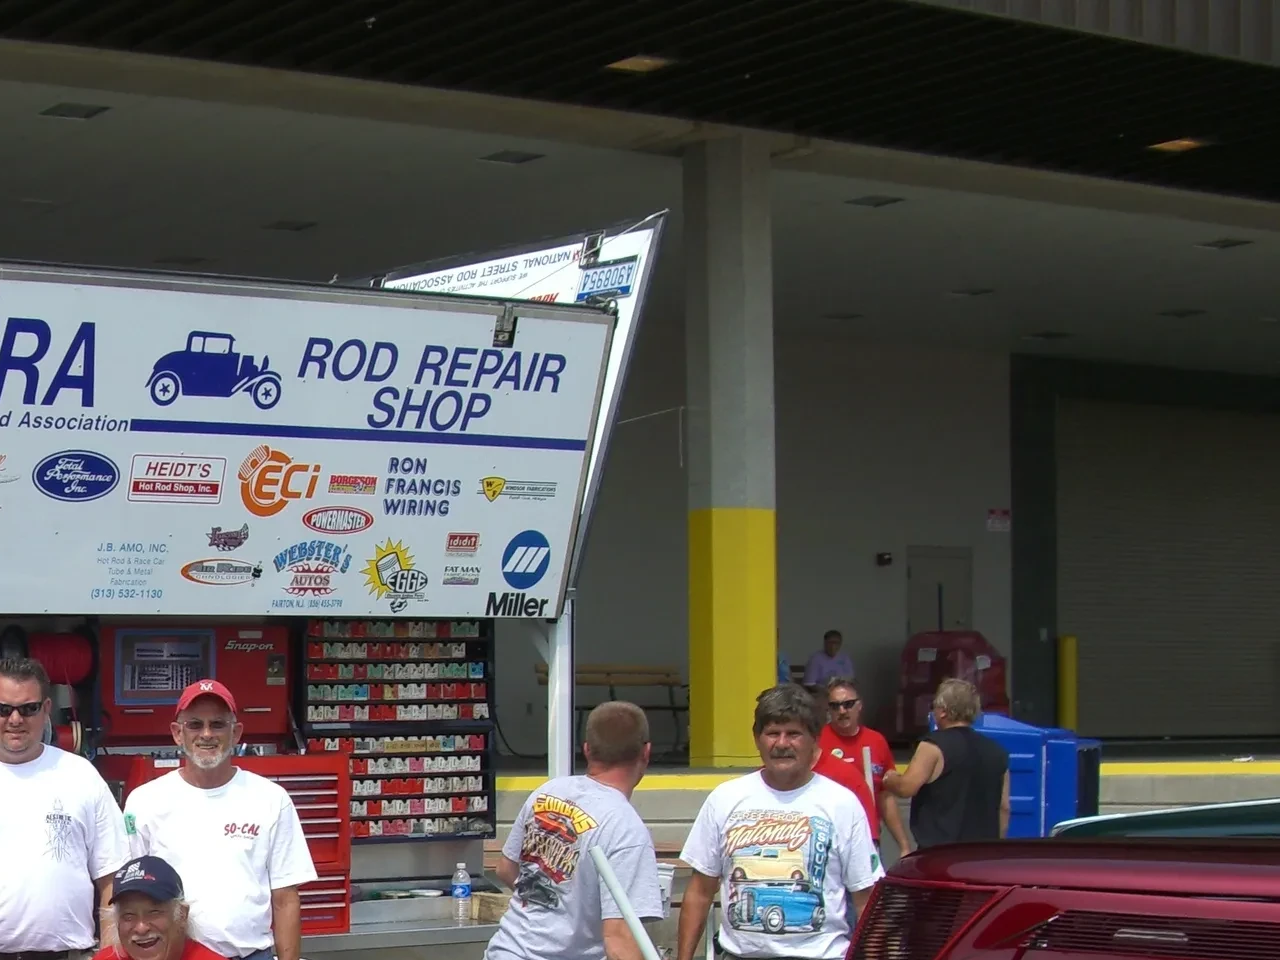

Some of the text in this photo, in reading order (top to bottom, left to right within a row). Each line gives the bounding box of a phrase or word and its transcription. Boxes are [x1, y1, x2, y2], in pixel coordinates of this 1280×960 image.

[521, 250, 570, 269] NATIONAL
[453, 269, 478, 283] ROD
[480, 261, 517, 278] STREET
[582, 264, 634, 291] A908954
[297, 336, 567, 394] ROD REPAIR
[366, 386, 492, 432] SHOP
[17, 411, 130, 432] Association
[55, 458, 84, 471] Total
[145, 462, 212, 478] HEIDT'S
[388, 457, 428, 475] RON
[44, 469, 113, 484] Performance
[329, 475, 378, 486] BORGESON
[64, 481, 88, 494] Inc.
[138, 483, 212, 493] Hot Rod Shop, Inc.
[385, 478, 462, 497] FRANCIS
[383, 499, 451, 517] WIRING
[311, 509, 367, 530] POWERMASTER
[97, 543, 169, 553] J.B. AMO, INC.
[449, 537, 476, 548] ididit
[97, 557, 110, 565] Hot
[111, 557, 125, 565] Rod
[134, 558, 151, 566] Race
[153, 558, 165, 566] Car
[273, 539, 353, 574] WEBSTER'S
[108, 568, 125, 576] Tube
[134, 568, 153, 576] Metal
[460, 566, 481, 574] MAN
[110, 578, 147, 586] Fabrication
[290, 575, 331, 587] AUTOS
[387, 570, 427, 592] EGGE
[91, 588, 163, 599] (313) 532-1130
[485, 592, 548, 617] Miller
[224, 640, 275, 653] Snap-on
[224, 822, 260, 836] SO-CAL
[725, 818, 812, 857] Nationals
[813, 832, 826, 890] SOUTH
